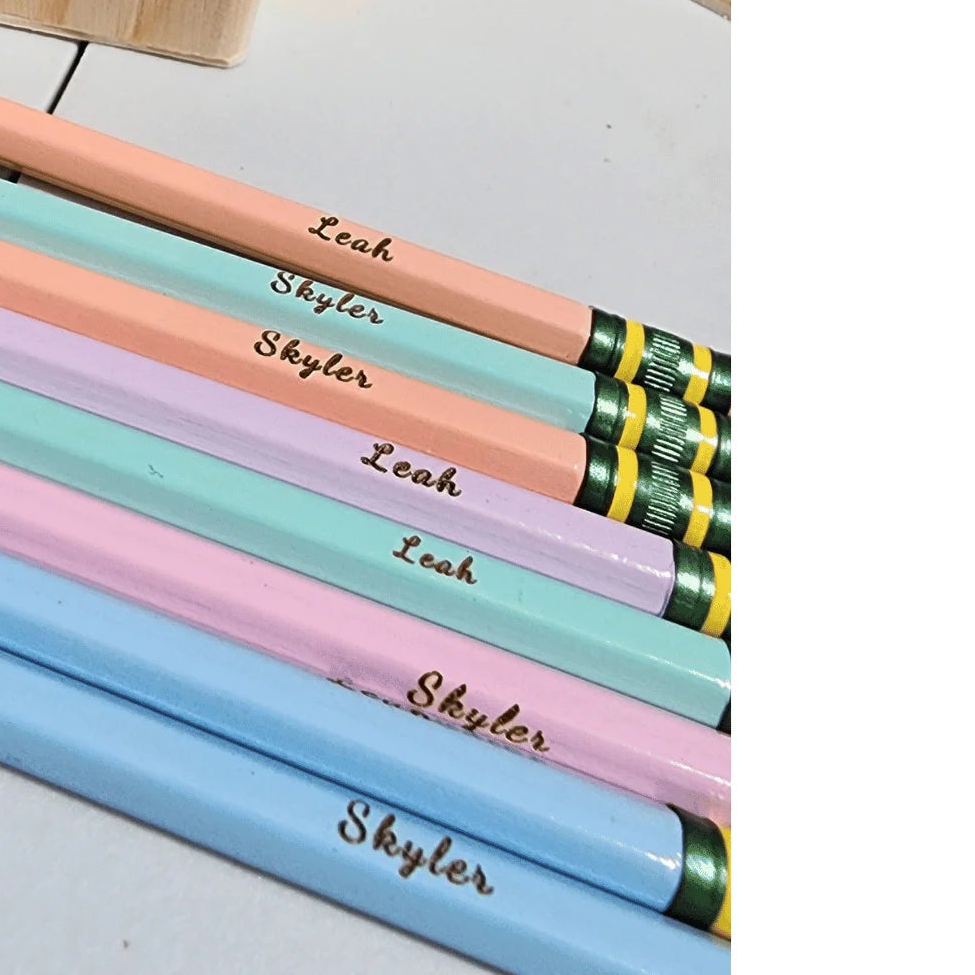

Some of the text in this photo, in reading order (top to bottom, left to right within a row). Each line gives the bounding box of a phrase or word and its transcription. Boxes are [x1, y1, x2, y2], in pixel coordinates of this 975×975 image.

[308, 216, 394, 262] Leah
[270, 271, 384, 325] Skyler
[254, 329, 373, 389] Skyler
[360, 442, 462, 497] Leah
[392, 535, 478, 585] Leah
[406, 670, 550, 753] Skyler
[338, 799, 494, 896] Skyler
